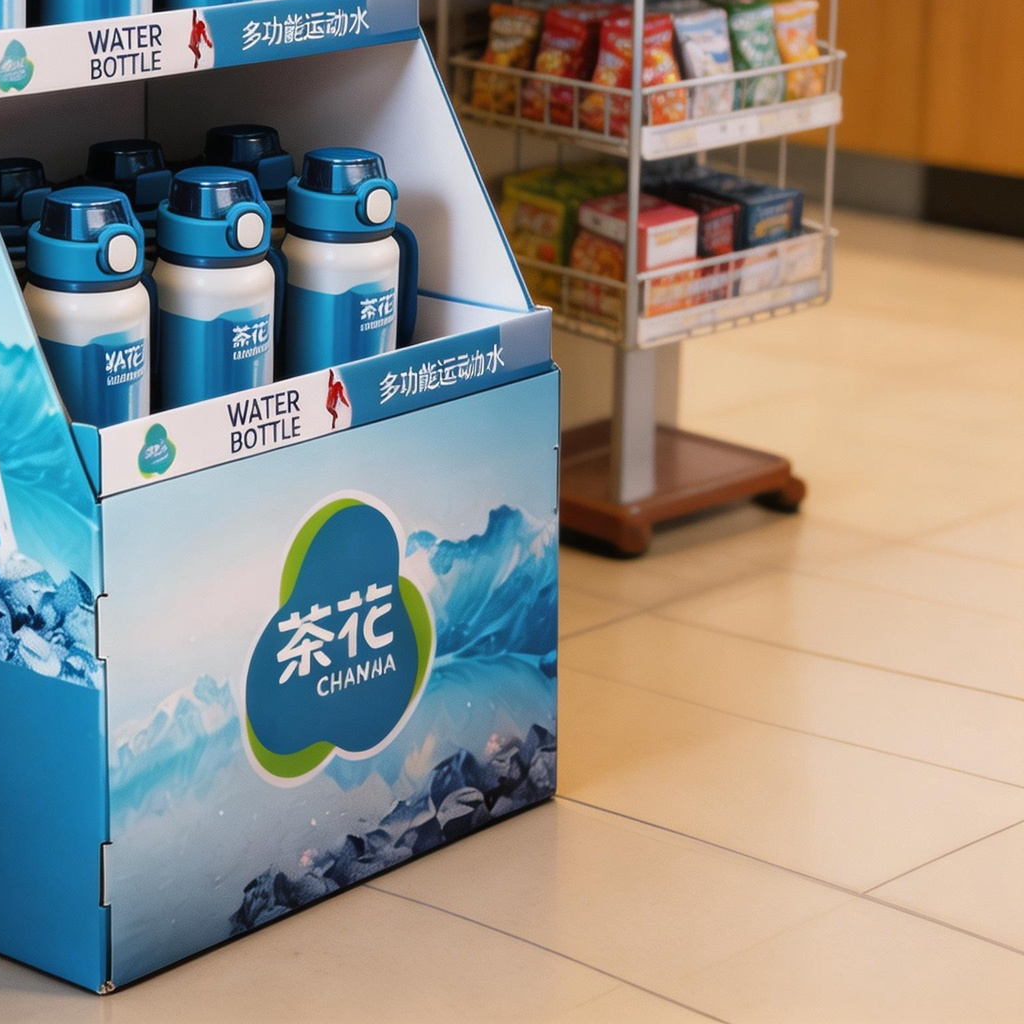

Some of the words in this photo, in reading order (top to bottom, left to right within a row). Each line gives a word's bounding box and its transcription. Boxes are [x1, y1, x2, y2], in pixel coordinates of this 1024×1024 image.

[88, 24, 163, 55] WATER
[91, 50, 162, 80] BOTTLE
[227, 390, 301, 427] WATER
[230, 416, 301, 454] BOTTLE
[276, 583, 393, 684] 茶花
